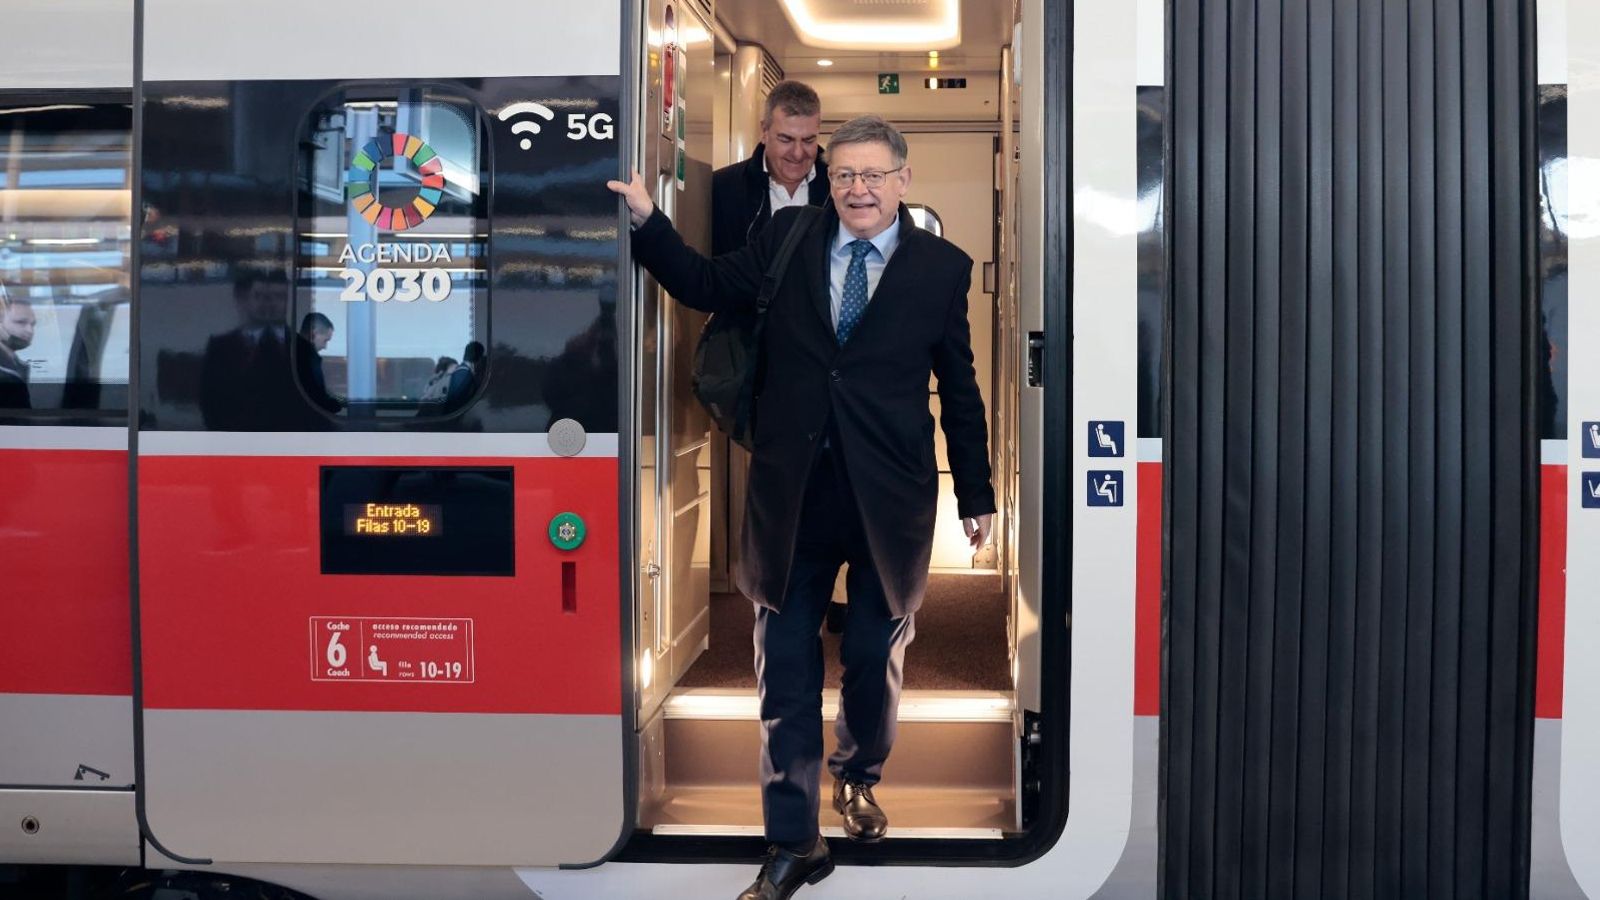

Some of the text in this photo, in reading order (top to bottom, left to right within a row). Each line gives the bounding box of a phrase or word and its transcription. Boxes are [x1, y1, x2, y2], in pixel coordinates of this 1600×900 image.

[566, 112, 614, 141] 5G
[338, 243, 452, 264] AGENDA
[338, 267, 452, 302] 2030
[366, 503, 420, 518] Entrada
[356, 518, 431, 533] Filas 10-19
[327, 621, 351, 631] Coche
[372, 622, 458, 631] acceso recomendado
[373, 631, 454, 640] recommended access
[326, 631, 347, 668] 6
[327, 667, 351, 677] Coach
[420, 661, 462, 678] 10-19
